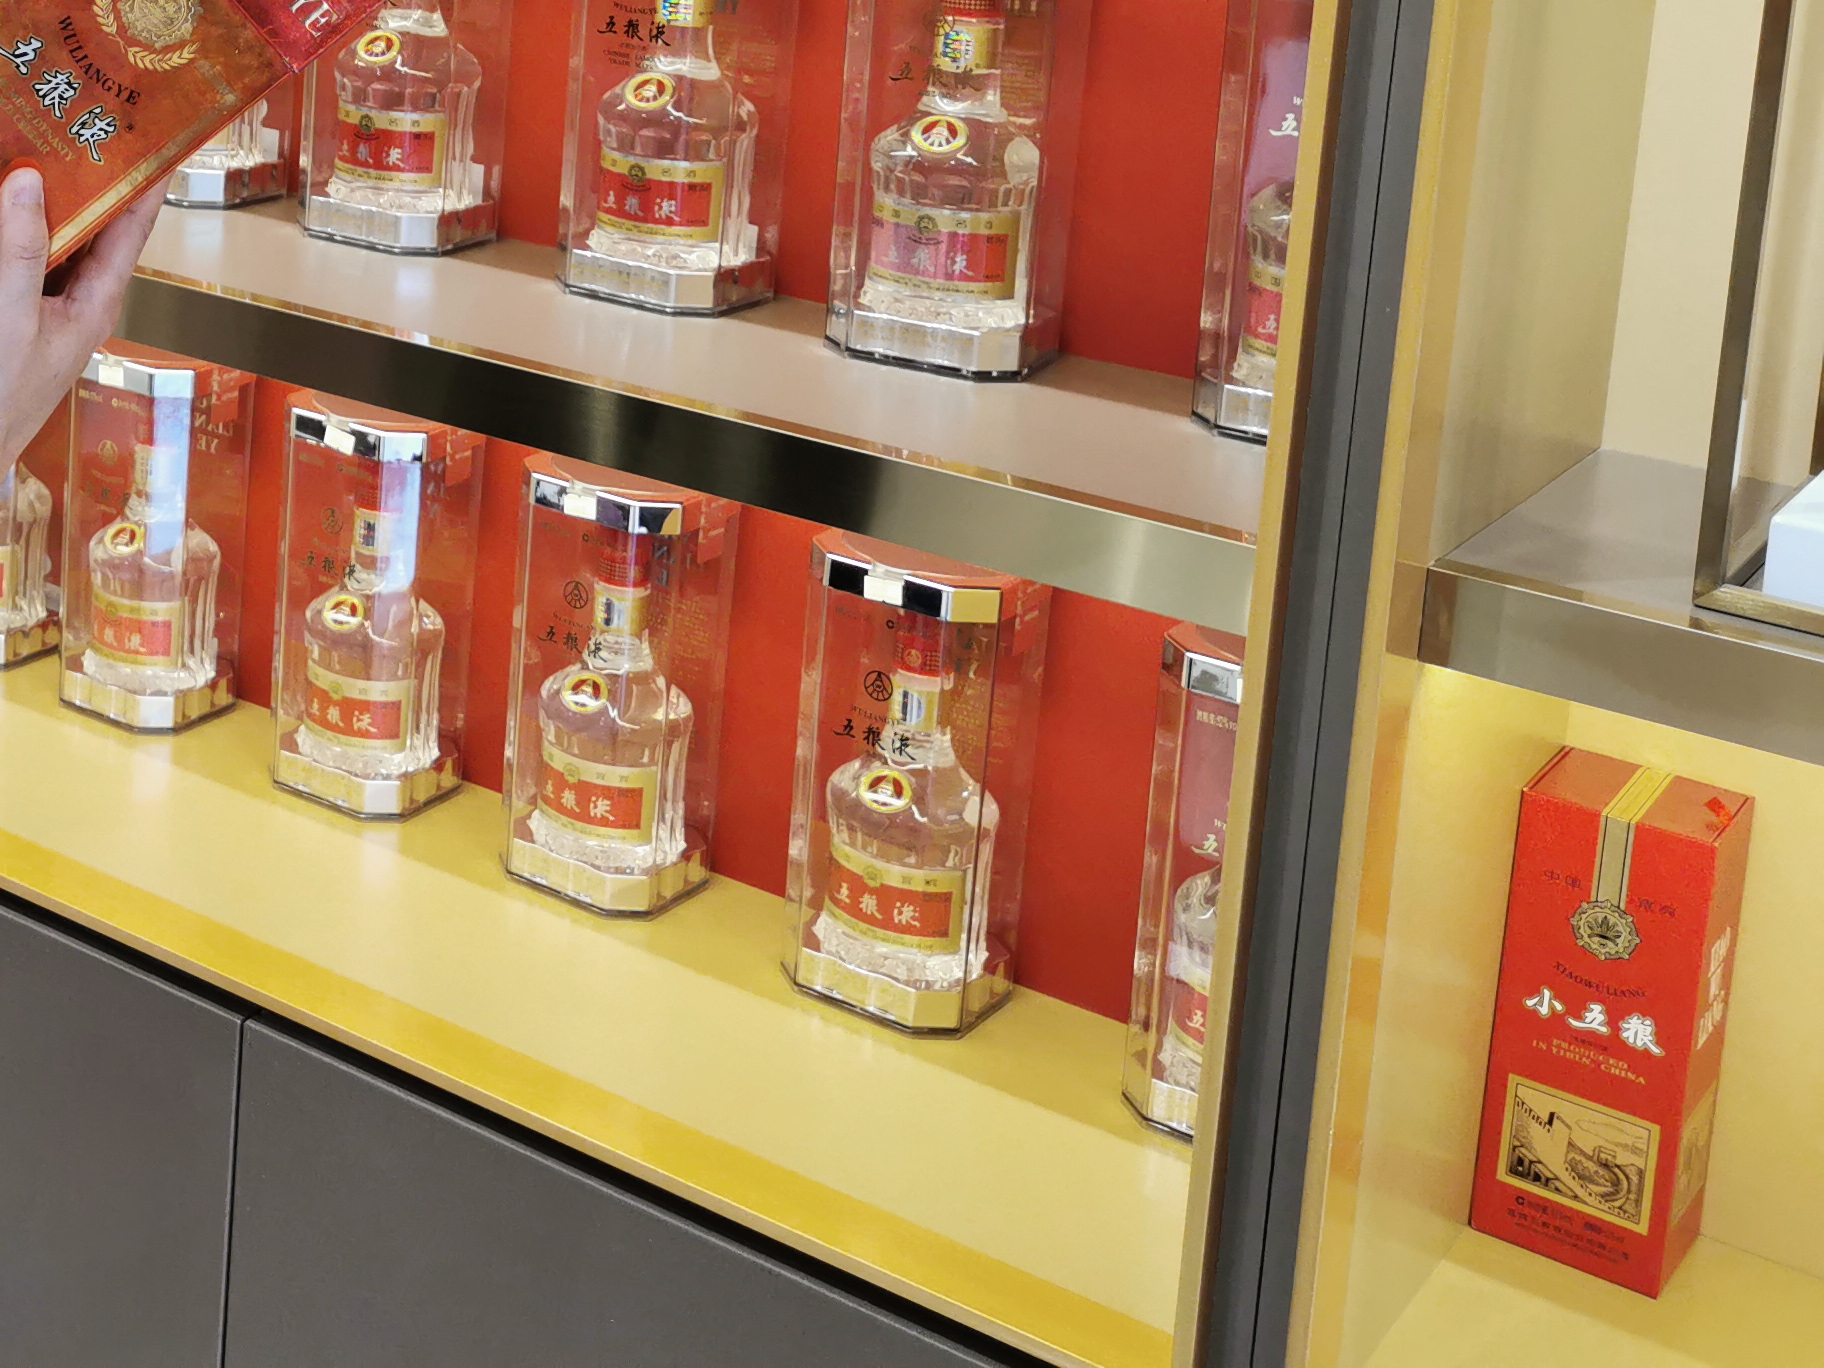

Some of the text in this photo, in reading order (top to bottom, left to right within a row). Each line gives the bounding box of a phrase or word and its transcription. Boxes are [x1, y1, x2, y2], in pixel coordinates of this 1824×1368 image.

[597, 15, 672, 47] 五粮液
[58, 15, 142, 106] WULIANGYE
[8, 86, 33, 121] MING
[32, 114, 76, 163] DYNASTY
[13, 113, 51, 155] CELLAR
[299, 550, 362, 584] 五粮液
[537, 625, 608, 663] 五粮液
[310, 697, 379, 734] 五粮液
[832, 718, 917, 762] 五粮液
[542, 779, 616, 821] 五粮液
[834, 882, 921, 928] 五粮液
[1523, 986, 1666, 1057] 小五粮
[1532, 1039, 1548, 1051] IN
[1600, 1063, 1646, 1085] CHINA
[1551, 1038, 1629, 1069] PRODUCED
